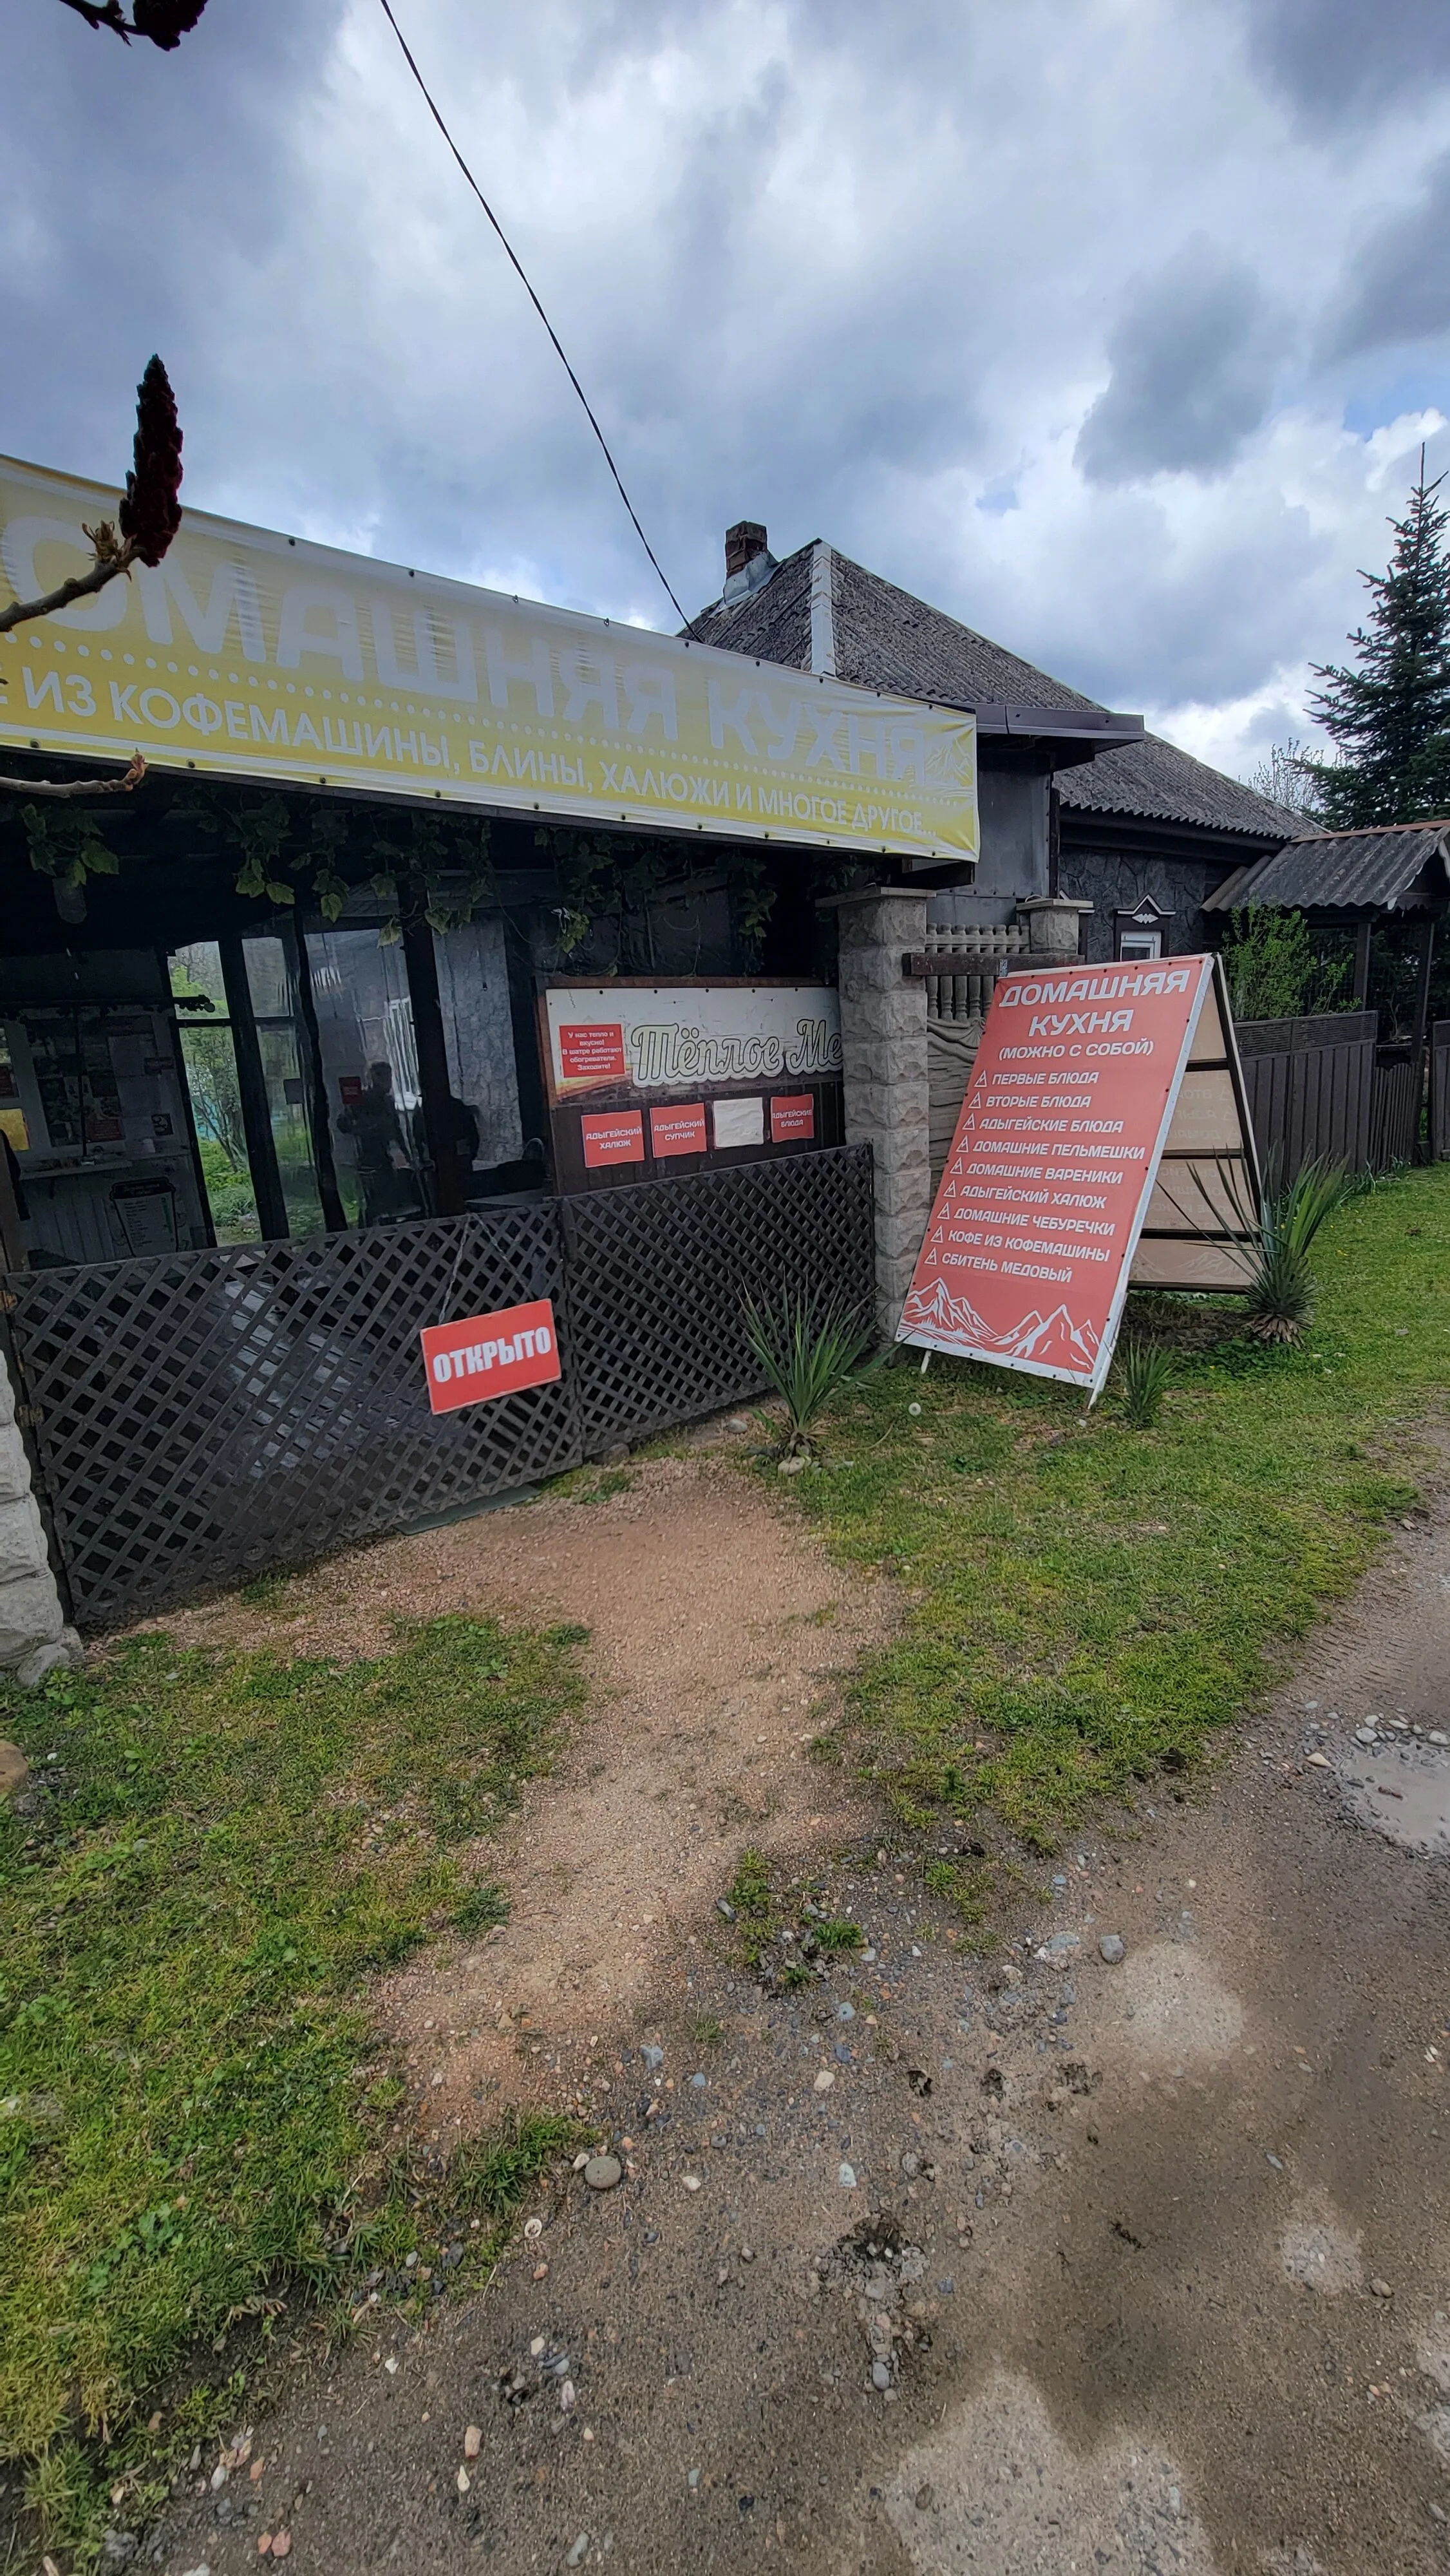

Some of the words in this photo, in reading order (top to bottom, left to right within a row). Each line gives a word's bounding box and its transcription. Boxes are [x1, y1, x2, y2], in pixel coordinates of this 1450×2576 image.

[708, 679, 925, 786] КУХНЯ
[22, 665, 97, 717] ИЗ
[109, 679, 460, 774] КОФЕМАШИНЫ,
[469, 740, 594, 793] БЛИНЫ,
[599, 760, 730, 808] ХАЛЮЖИ
[736, 782, 752, 811] И
[758, 787, 847, 826] МНОГОЕ
[851, 802, 936, 836] ДРУГОЕ...
[999, 969, 1191, 1007] ДОМАШНЯЯ
[1028, 1009, 1134, 1037] КУХНЯ
[631, 1023, 780, 1081] Тёплое
[999, 1044, 1065, 1061] (МОЖНО
[1069, 1044, 1081, 1057] С
[1086, 1037, 1154, 1056] СОБОЙ)
[992, 1073, 1046, 1085] ПЕРВЫЕ
[1048, 1072, 1100, 1084] БЛЮДА
[986, 1095, 1039, 1107] ВТОРЫЕ
[1040, 1095, 1092, 1108] БЛЮДА
[586, 1126, 643, 1141] АДЫГЕЙСКИЙ
[654, 1118, 705, 1132] АДЫГЕЙСКИЙ
[664, 1130, 696, 1141] СУПЧИК
[781, 1119, 804, 1128] БЛЮДА
[979, 1116, 1068, 1132] АДЫГЕЙСКИЕ
[1070, 1120, 1124, 1133] БЛЮДА
[599, 1139, 632, 1150] ХАЛЮЖ
[973, 1141, 1050, 1155] ДОМАШНИЕ
[1051, 1144, 1145, 1160] ПЕЛЬМЕШКИ
[966, 1163, 1043, 1179] ДОМАШНИЕ
[1044, 1167, 1124, 1184] ВАРЕНИКИ
[960, 1185, 1049, 1204] АДЫГЕЙСКИЙ
[1050, 1193, 1107, 1209] ХАЛЮЖ
[954, 1208, 1030, 1227] ДОМАШНИЕ
[1032, 1216, 1116, 1236] ЧЕБУРЕЧКИ
[948, 1229, 983, 1245] КОФЕ
[984, 1235, 1003, 1247] ИЗ
[1004, 1236, 1111, 1262] КОФЕМАШИНЫ
[941, 1253, 998, 1271] СБИТЕНЬ
[1001, 1261, 1073, 1283] МЕДОВЫЙ
[433, 1327, 551, 1383] ОТКРЫТО
